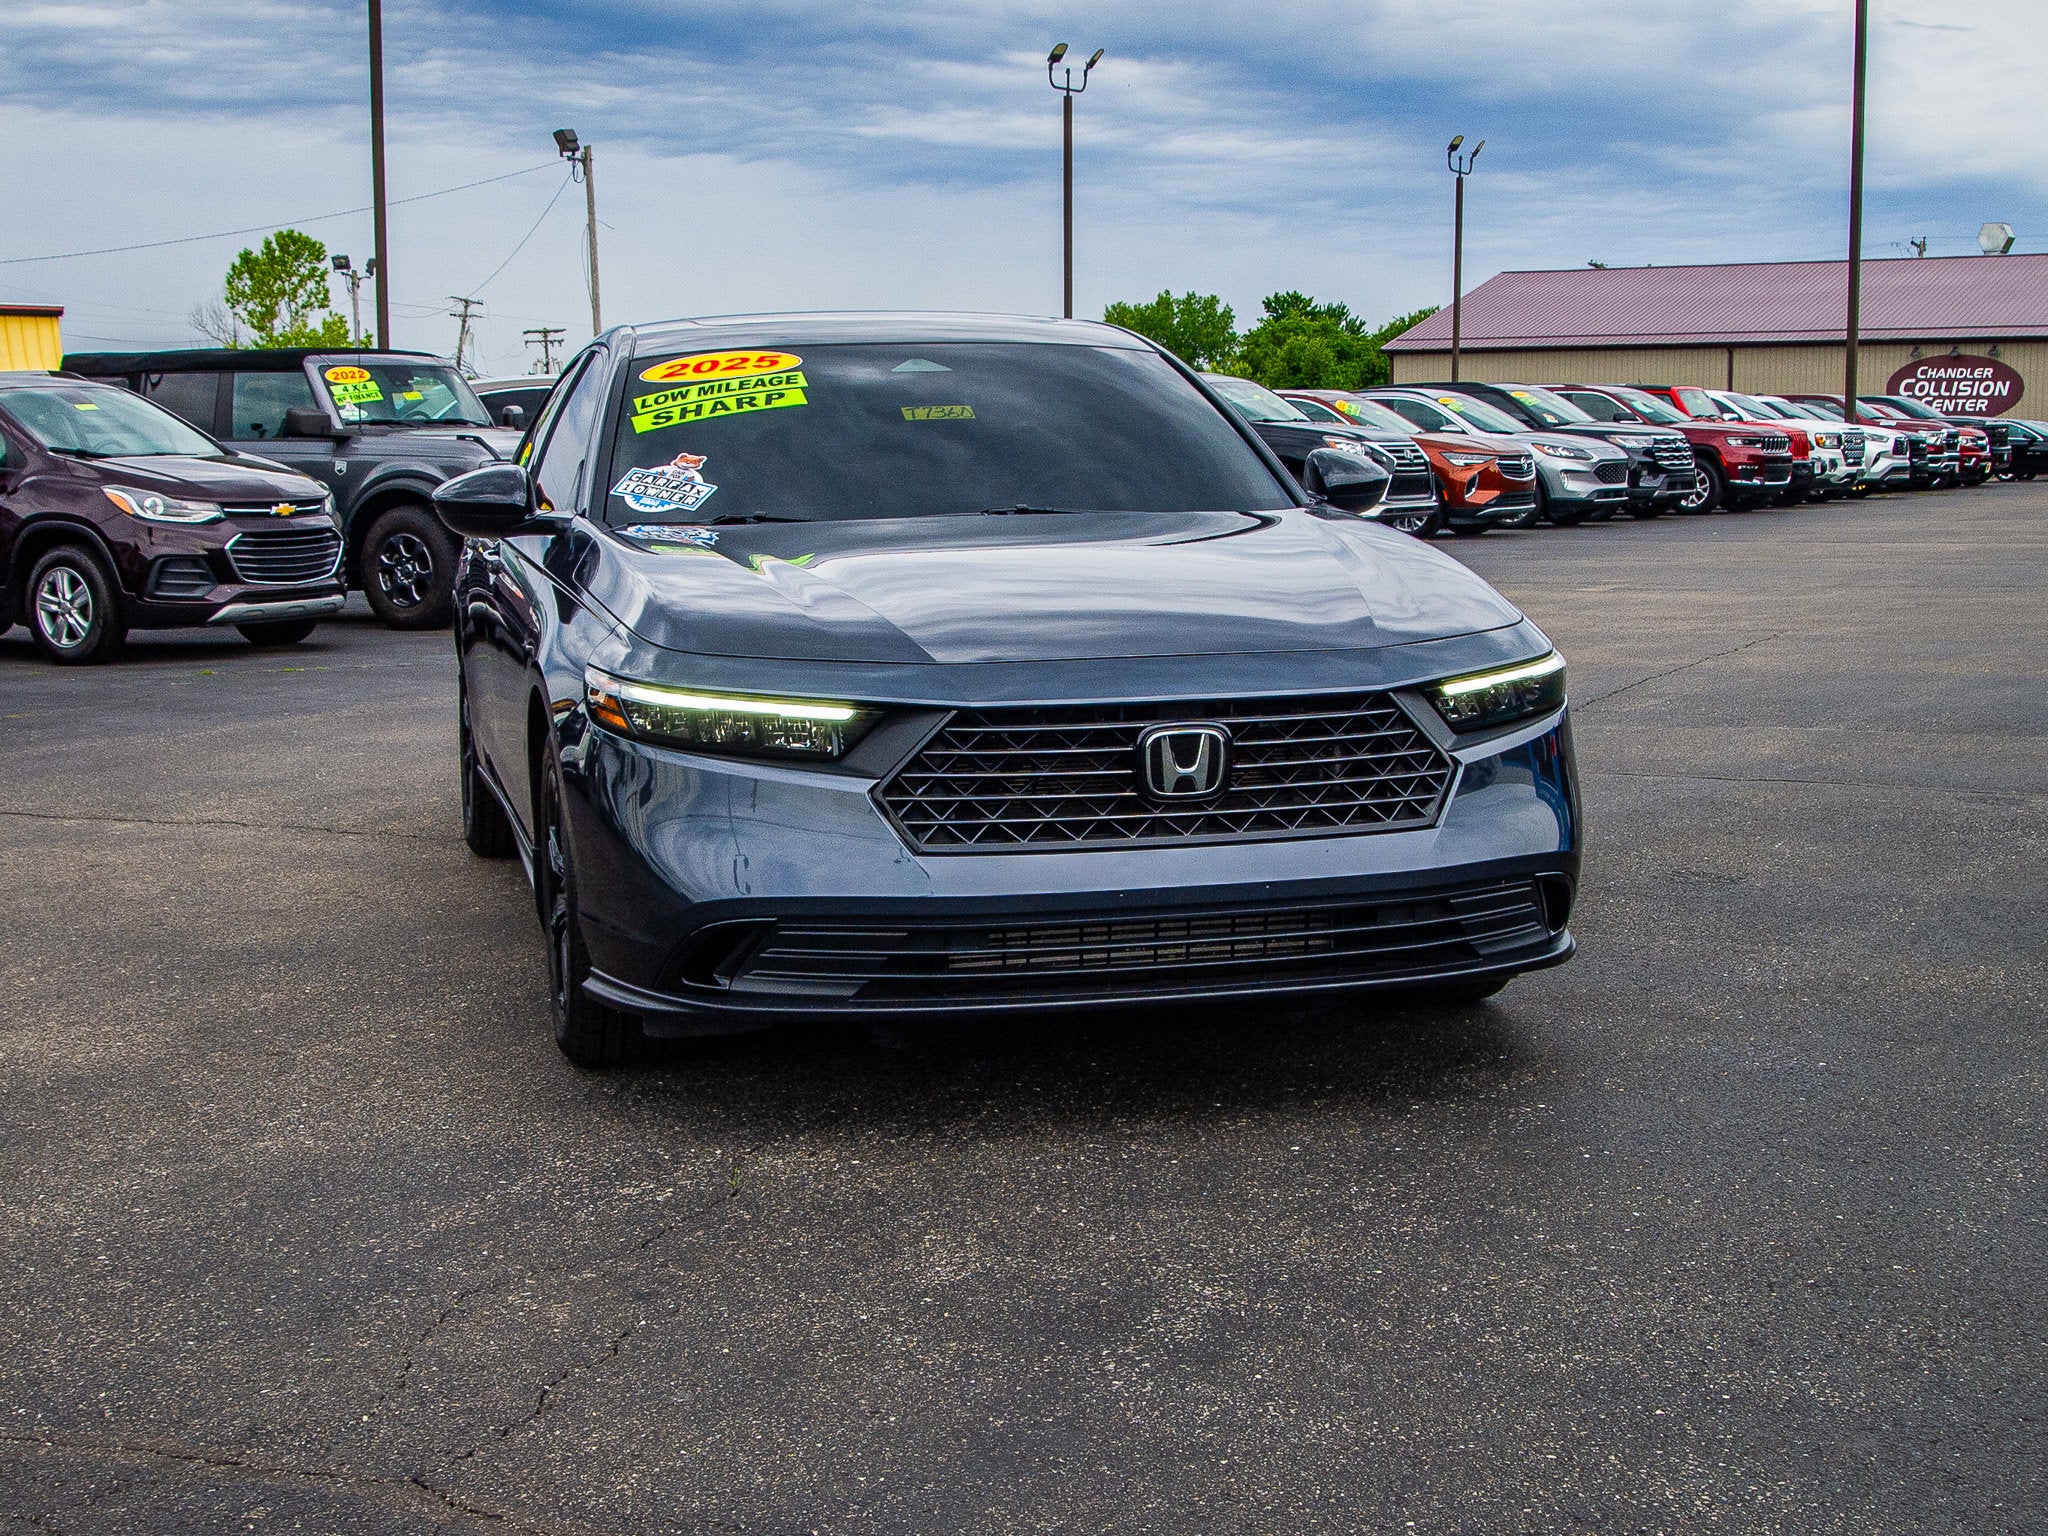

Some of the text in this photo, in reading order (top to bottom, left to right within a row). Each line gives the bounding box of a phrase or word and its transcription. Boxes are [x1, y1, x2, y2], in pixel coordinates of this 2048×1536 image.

[332, 370, 366, 380] 2022
[658, 354, 782, 380] 2025
[1916, 366, 1994, 379] CHANDLER
[349, 392, 380, 401] FINANCE
[640, 374, 800, 410] LOW MILEAGE
[1898, 378, 2011, 397] COLLISION
[650, 391, 787, 426] SHARP
[628, 473, 705, 497] CARFAX
[632, 485, 698, 505] OWNER
